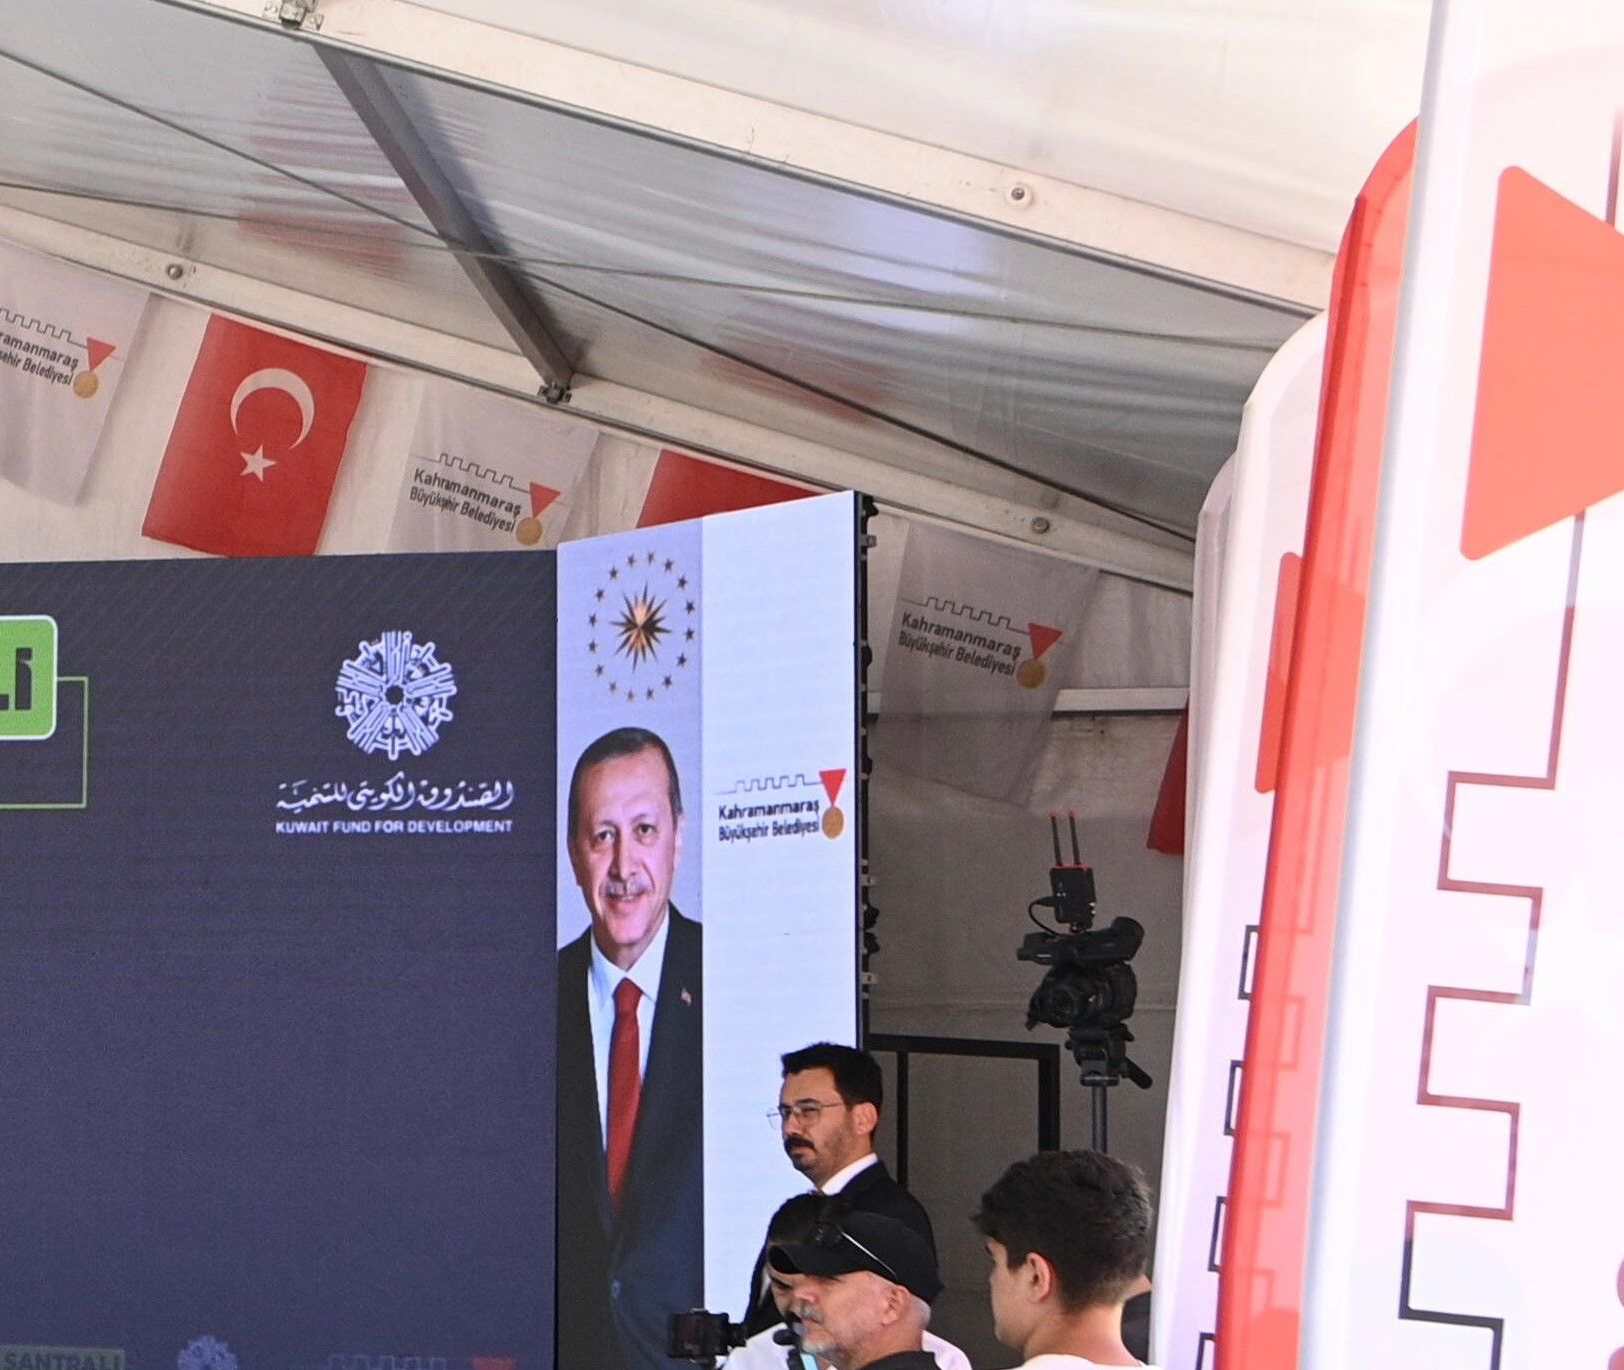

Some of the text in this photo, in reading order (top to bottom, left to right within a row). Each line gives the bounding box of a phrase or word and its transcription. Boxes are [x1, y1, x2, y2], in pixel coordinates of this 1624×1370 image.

[414, 468, 521, 518] Kahramanmaraş
[460, 501, 515, 532] Belediyesi
[901, 612, 1021, 661] Kahramanmaraş
[955, 646, 1016, 676] Belediyesi
[719, 800, 820, 820] Kahramanmaraş
[276, 819, 512, 834] KUWAIT FUND FOR DEVELOPMENT
